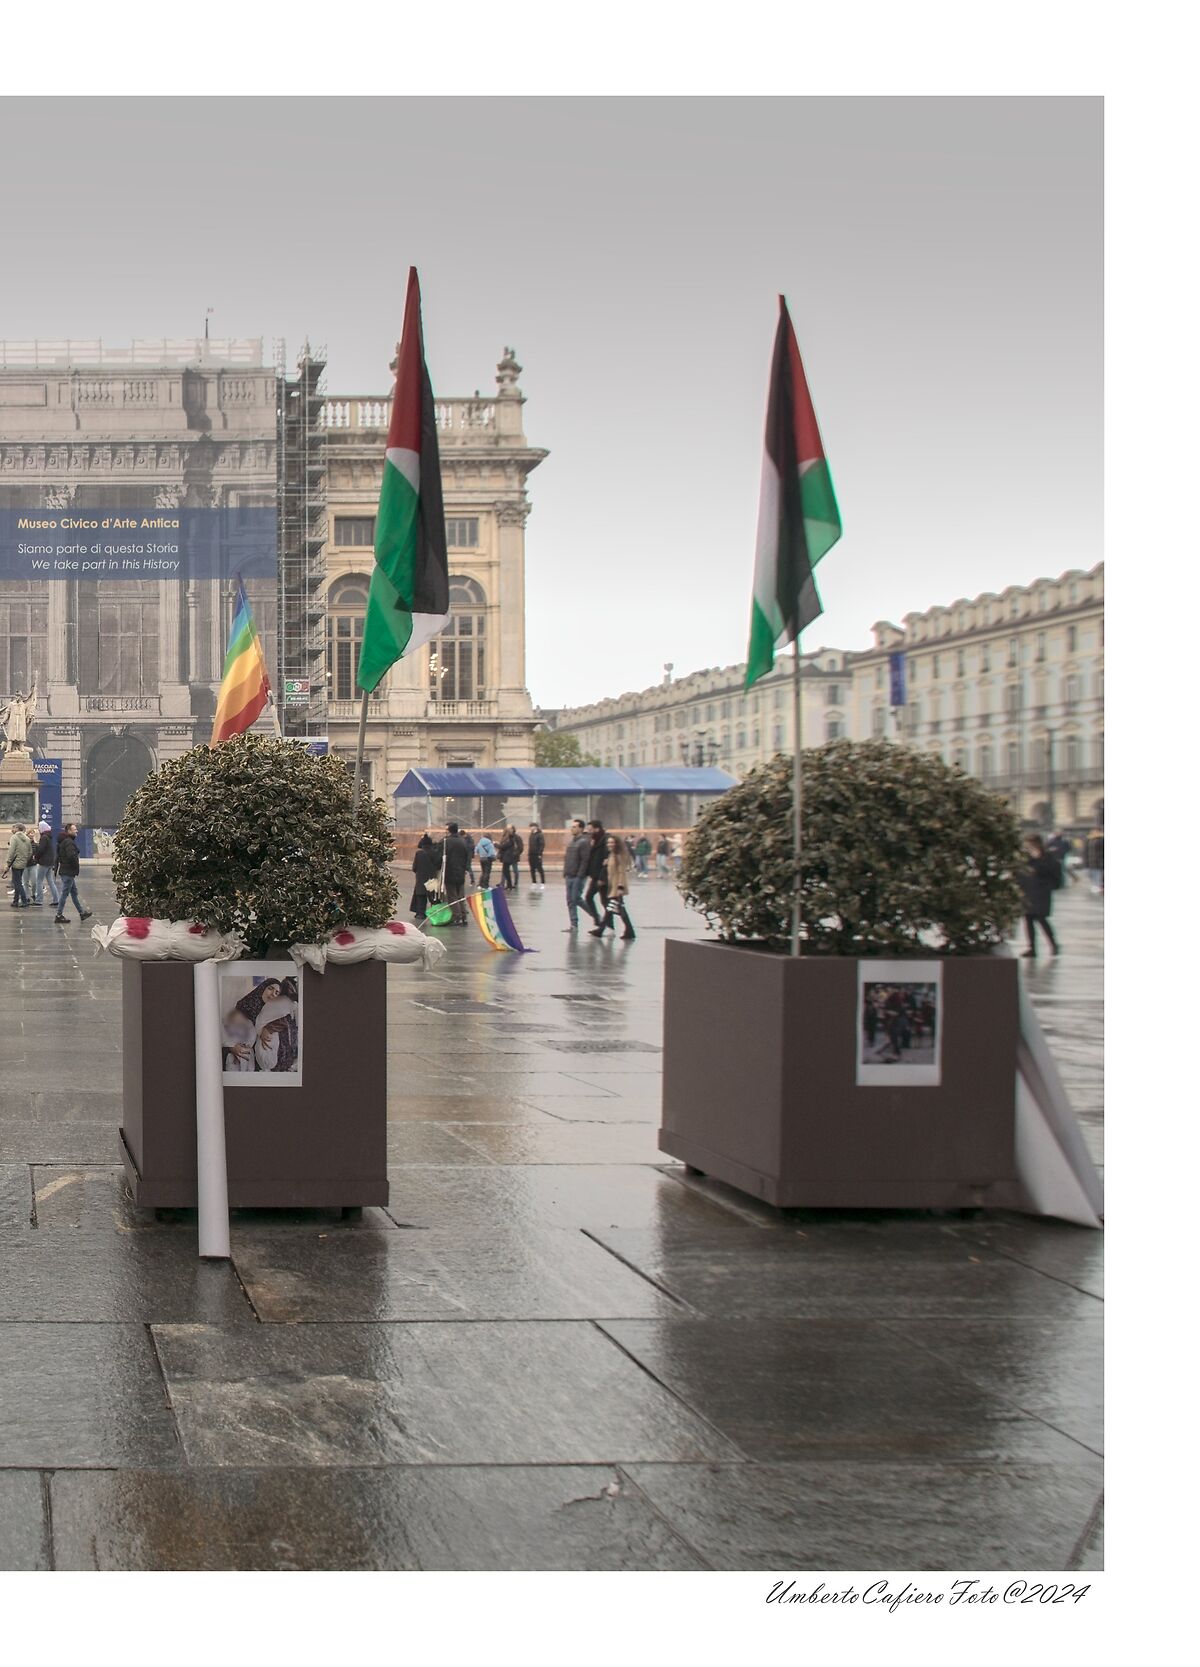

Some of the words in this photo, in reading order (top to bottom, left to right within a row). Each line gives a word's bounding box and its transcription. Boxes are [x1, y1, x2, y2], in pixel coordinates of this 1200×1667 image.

[17, 518, 57, 529] Museo
[60, 518, 98, 529] Civico
[101, 518, 137, 529] d'Arte
[141, 518, 179, 528] Antica
[17, 543, 53, 554] Siamo
[56, 544, 87, 556] parte
[91, 543, 101, 554] di
[104, 544, 143, 556] questa
[146, 543, 178, 554] Storia
[31, 560, 50, 569] We
[54, 559, 79, 569] take
[82, 560, 106, 571] part
[108, 560, 119, 569] in
[122, 559, 140, 569] this
[143, 559, 180, 571] History
